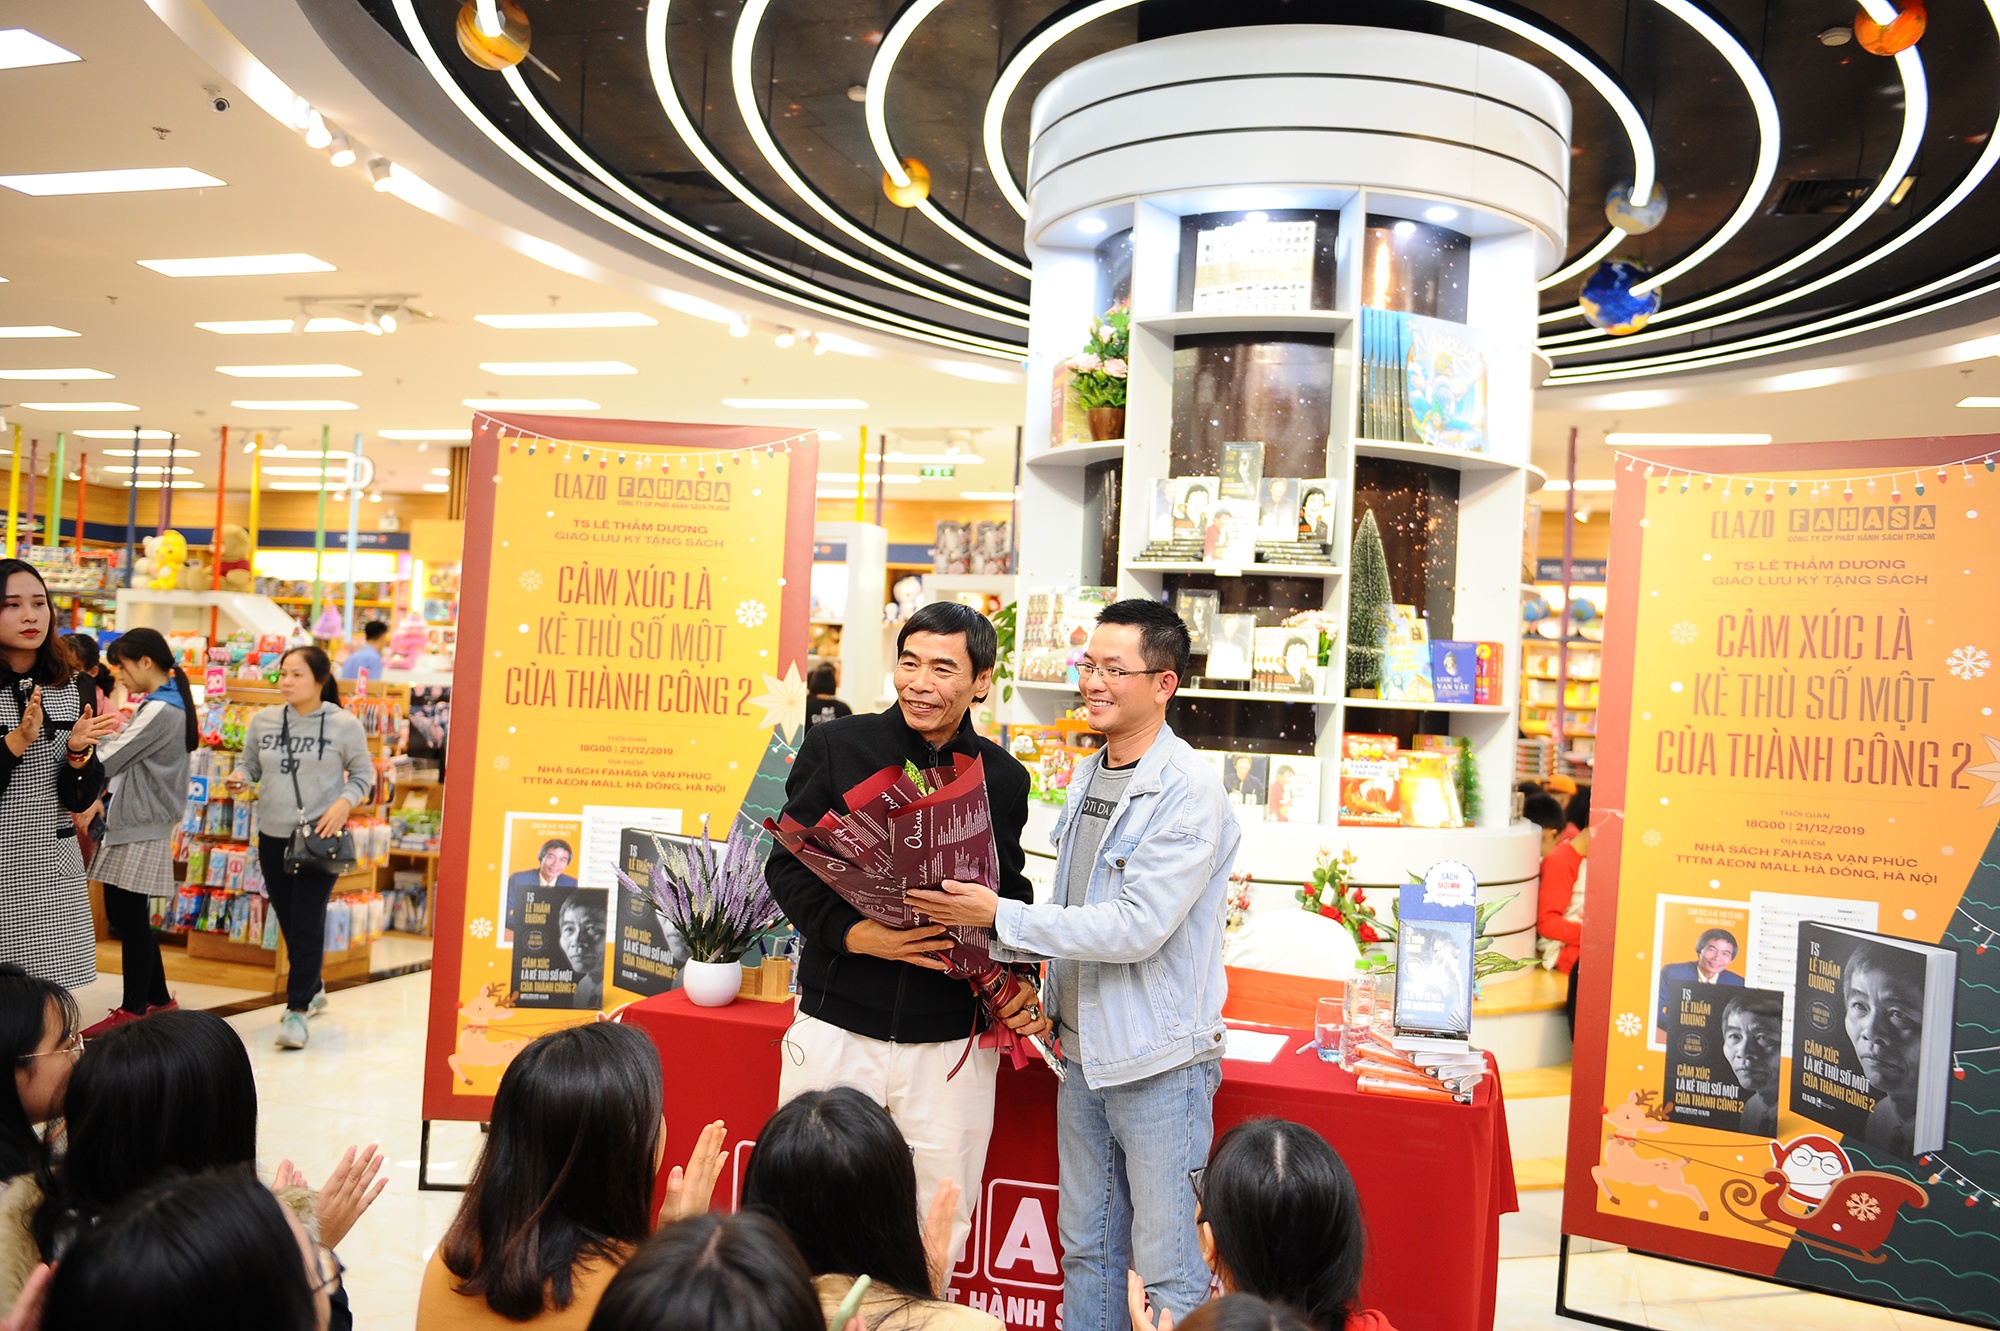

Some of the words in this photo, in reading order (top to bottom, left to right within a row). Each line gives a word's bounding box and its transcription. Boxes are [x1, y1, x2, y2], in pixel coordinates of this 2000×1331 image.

[618, 476, 731, 503] FAHASA
[573, 519, 590, 528] TS
[594, 518, 610, 530] LÊ
[614, 518, 653, 532] THẨM
[657, 523, 708, 534] DƯƠNG
[1788, 505, 1936, 533] FAHASA
[554, 532, 590, 542] GIAO
[593, 534, 620, 543] LƯU
[624, 533, 641, 544] KÝ
[644, 536, 682, 547] TẶNG
[685, 536, 724, 548] SÁCH
[1788, 534, 1808, 542] CÔNG
[1822, 534, 1833, 542] CP
[1835, 533, 1856, 542] PHÁT
[1857, 533, 1880, 542] HÀNH
[1882, 532, 1904, 541] SÁCH
[1906, 532, 1936, 540] TP.HCM
[1734, 560, 1754, 571] TS
[1759, 558, 1779, 571] LÊ
[1782, 556, 1834, 570] THẨM
[1838, 559, 1906, 570] DƯƠNG
[558, 561, 618, 606] CẢM
[624, 564, 676, 608] XÚC
[683, 566, 712, 611] LÀ
[1712, 576, 1754, 586] GIAO
[1758, 575, 1794, 586] LƯU
[1797, 572, 1820, 586] KÝ
[1822, 571, 1872, 588] TẶNG
[1876, 573, 1928, 586] SÁCH
[538, 611, 568, 656] KẺ
[574, 613, 622, 658] THÙ
[629, 614, 666, 660] SỐ
[670, 618, 728, 669] MỘT
[1715, 607, 1790, 659] CẢM
[1798, 607, 1865, 661] XÚC
[1874, 607, 1914, 661] LÀ
[206, 673, 222, 690] 20
[505, 662, 556, 707] CỦA
[566, 665, 650, 712] THÀNH
[658, 669, 730, 716] CÔNG
[736, 678, 753, 716] 2
[1692, 666, 1730, 717] KẺ
[1736, 666, 1796, 720] THÙ
[1806, 665, 1855, 722] SỐ
[1859, 669, 1936, 732] MỘT
[580, 744, 612, 752] 18G00
[620, 745, 674, 755] 21/12/2019
[1654, 724, 1717, 776] CỦA
[1726, 726, 1834, 783] THÀNH
[1843, 731, 1940, 788] CÔNG
[1950, 741, 1973, 790] 2
[537, 765, 564, 774] NHÀ
[566, 764, 599, 776] SÁCH
[602, 768, 648, 778] FAHASA
[652, 770, 676, 780] VẠN
[678, 770, 712, 780] PHÚC
[522, 776, 552, 786] TTTM
[556, 777, 588, 787] AEON
[591, 779, 623, 788] MALL
[626, 780, 643, 789] HÀ
[646, 780, 683, 792] ĐÔNG,
[686, 782, 702, 792] HÀ
[705, 784, 726, 794] NỘI
[1779, 810, 1804, 818] THỜI
[1804, 812, 1831, 820] GIAN
[1744, 819, 1786, 830] 18G00
[1796, 822, 1866, 836] 21/12/2019
[630, 844, 638, 857] TS
[1694, 841, 1724, 853] NHÀ
[1728, 842, 1770, 856] SÁCH
[1773, 848, 1834, 862] FAHASA
[1836, 853, 1870, 866] VẠN
[1872, 854, 1918, 868] PHÚC
[1675, 854, 1714, 866] TTTM
[1716, 858, 1757, 870] AEON
[1760, 860, 1802, 873] MALL
[1804, 862, 1826, 876] HÀ
[1829, 865, 1880, 881] ĐÔNG,
[1883, 868, 1907, 882] HÀ
[1909, 872, 1938, 886] NỘI
[1810, 940, 1820, 957] TS
[1682, 988, 1692, 1000] TS
[1804, 1040, 1822, 1058] CẢM
[1823, 1046, 1840, 1065] XÚC
[1804, 1056, 1813, 1072] LÀ
[1814, 1060, 1824, 1076] KẺ
[1824, 1062, 1839, 1081] THÙ
[1840, 1068, 1852, 1087] SỐ
[1852, 1074, 1870, 1094] MỘT
[1802, 1072, 1818, 1091] CỦA
[1820, 1078, 1845, 1100] THÀNH
[1846, 1088, 1868, 1111] CÔNG
[1868, 1098, 1876, 1114] 2
[969, 1287, 1046, 1328] HÀNH
